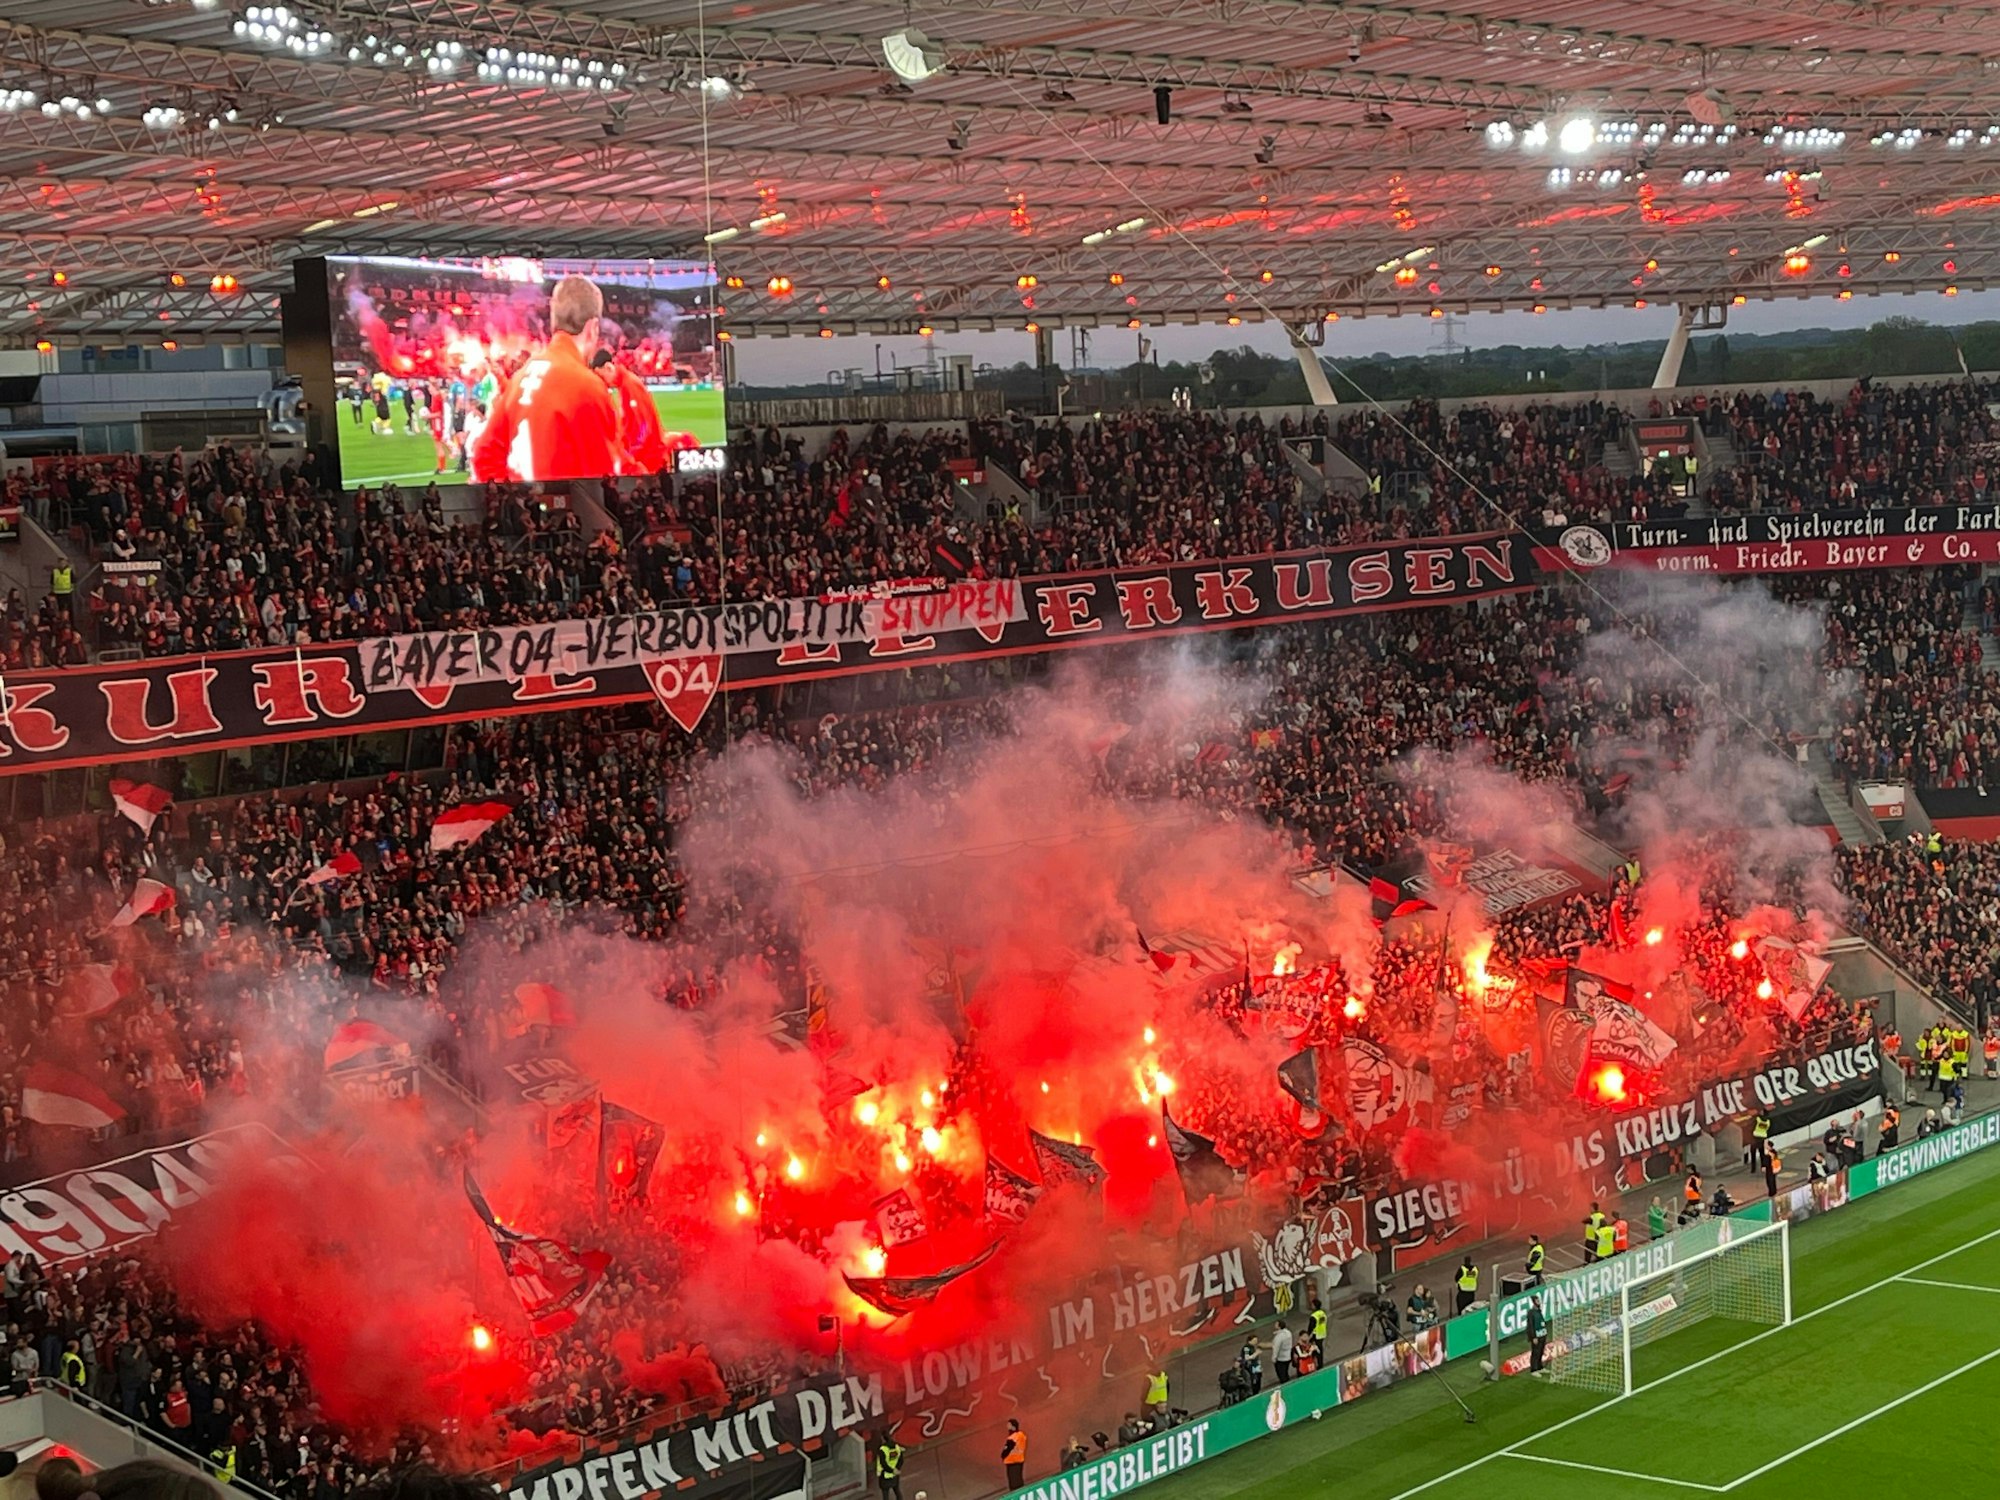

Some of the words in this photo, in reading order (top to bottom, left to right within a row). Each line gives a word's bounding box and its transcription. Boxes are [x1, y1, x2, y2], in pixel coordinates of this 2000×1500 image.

[678, 449, 724, 471] 20:43
[1626, 522, 1687, 548] Turn-
[1708, 516, 1748, 546] und
[1767, 512, 1885, 551] Spielverein
[1904, 507, 1938, 533] der
[1656, 553, 1719, 572] vorm.
[1737, 542, 1808, 570] Friedr.
[1826, 538, 1888, 567] Bayer
[1907, 538, 1925, 561] &
[1942, 535, 1977, 559] Co.
[371, 631, 504, 690] BAYER
[510, 627, 556, 675] 04
[881, 578, 1015, 631] STOPPEN
[655, 660, 713, 699] 04
[504, 1056, 579, 1085] FÜR
[1553, 1130, 1605, 1177] DAS
[1614, 1100, 1701, 1158] KREUZ
[1702, 1080, 1748, 1126] AUF
[1806, 1037, 1880, 1090] BRUST
[692, 1400, 780, 1472] MIT
[796, 1373, 885, 1440] DEM
[1050, 1297, 1095, 1350] IM
[1110, 1248, 1247, 1332] HERZEN
